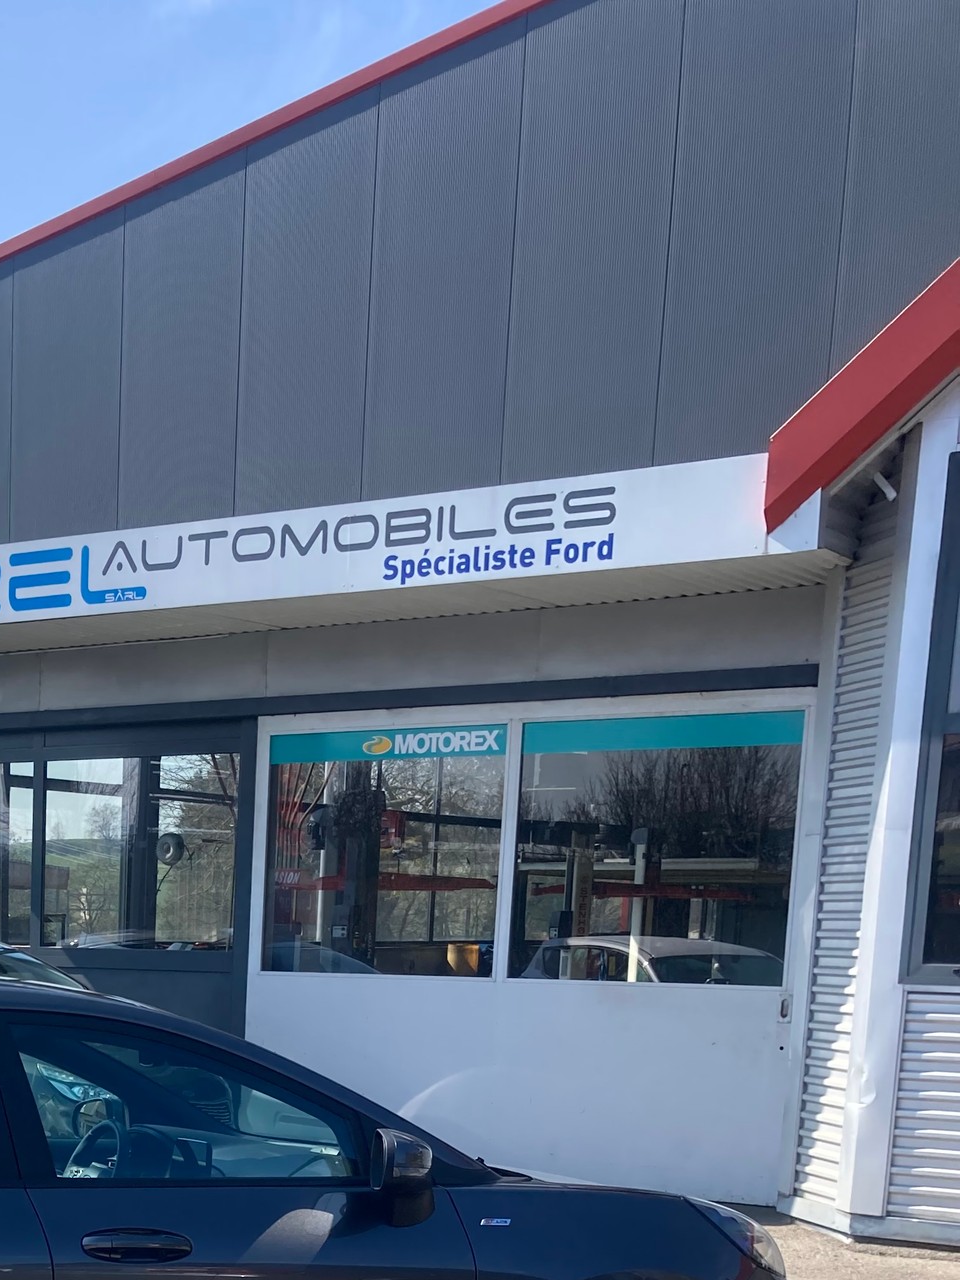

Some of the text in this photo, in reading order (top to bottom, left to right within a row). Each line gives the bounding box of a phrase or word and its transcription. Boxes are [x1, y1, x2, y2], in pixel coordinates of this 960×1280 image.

[101, 486, 617, 576] AUTOMOBILES
[382, 533, 615, 585] Spécialiste Ford
[394, 730, 500, 754] MOTOREX
